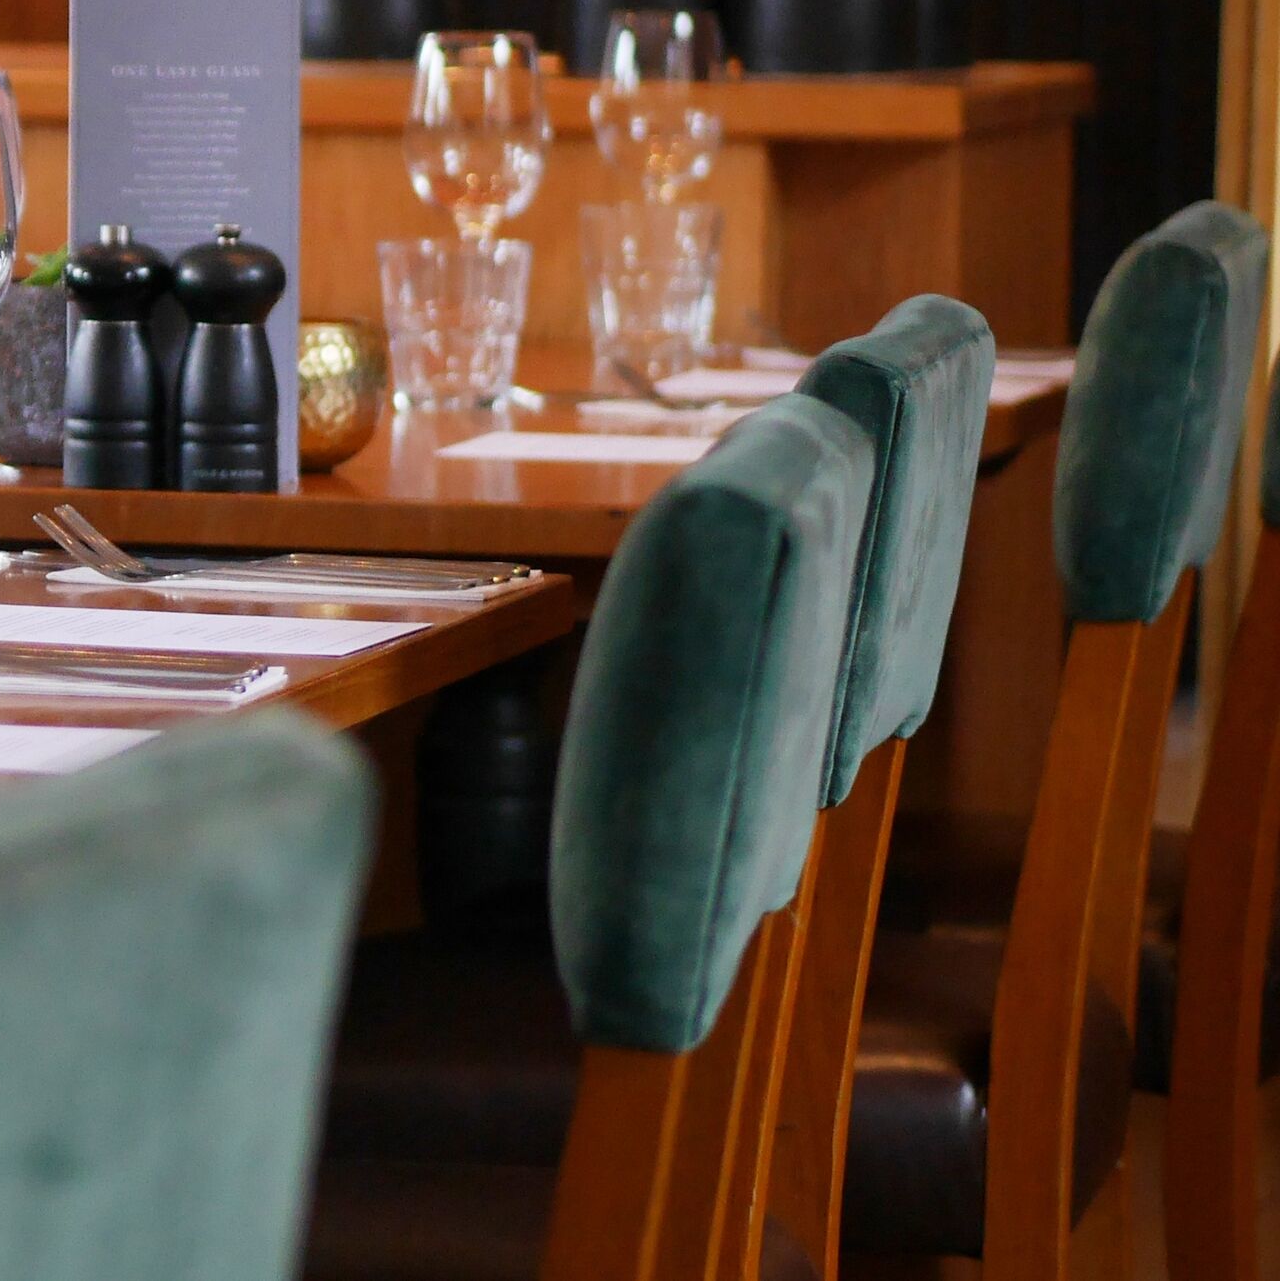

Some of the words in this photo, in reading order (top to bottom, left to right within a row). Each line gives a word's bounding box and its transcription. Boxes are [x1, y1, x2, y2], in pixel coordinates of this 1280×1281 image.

[111, 64, 148, 78] ONE
[155, 64, 198, 78] LAST
[206, 65, 262, 78] GLASS
